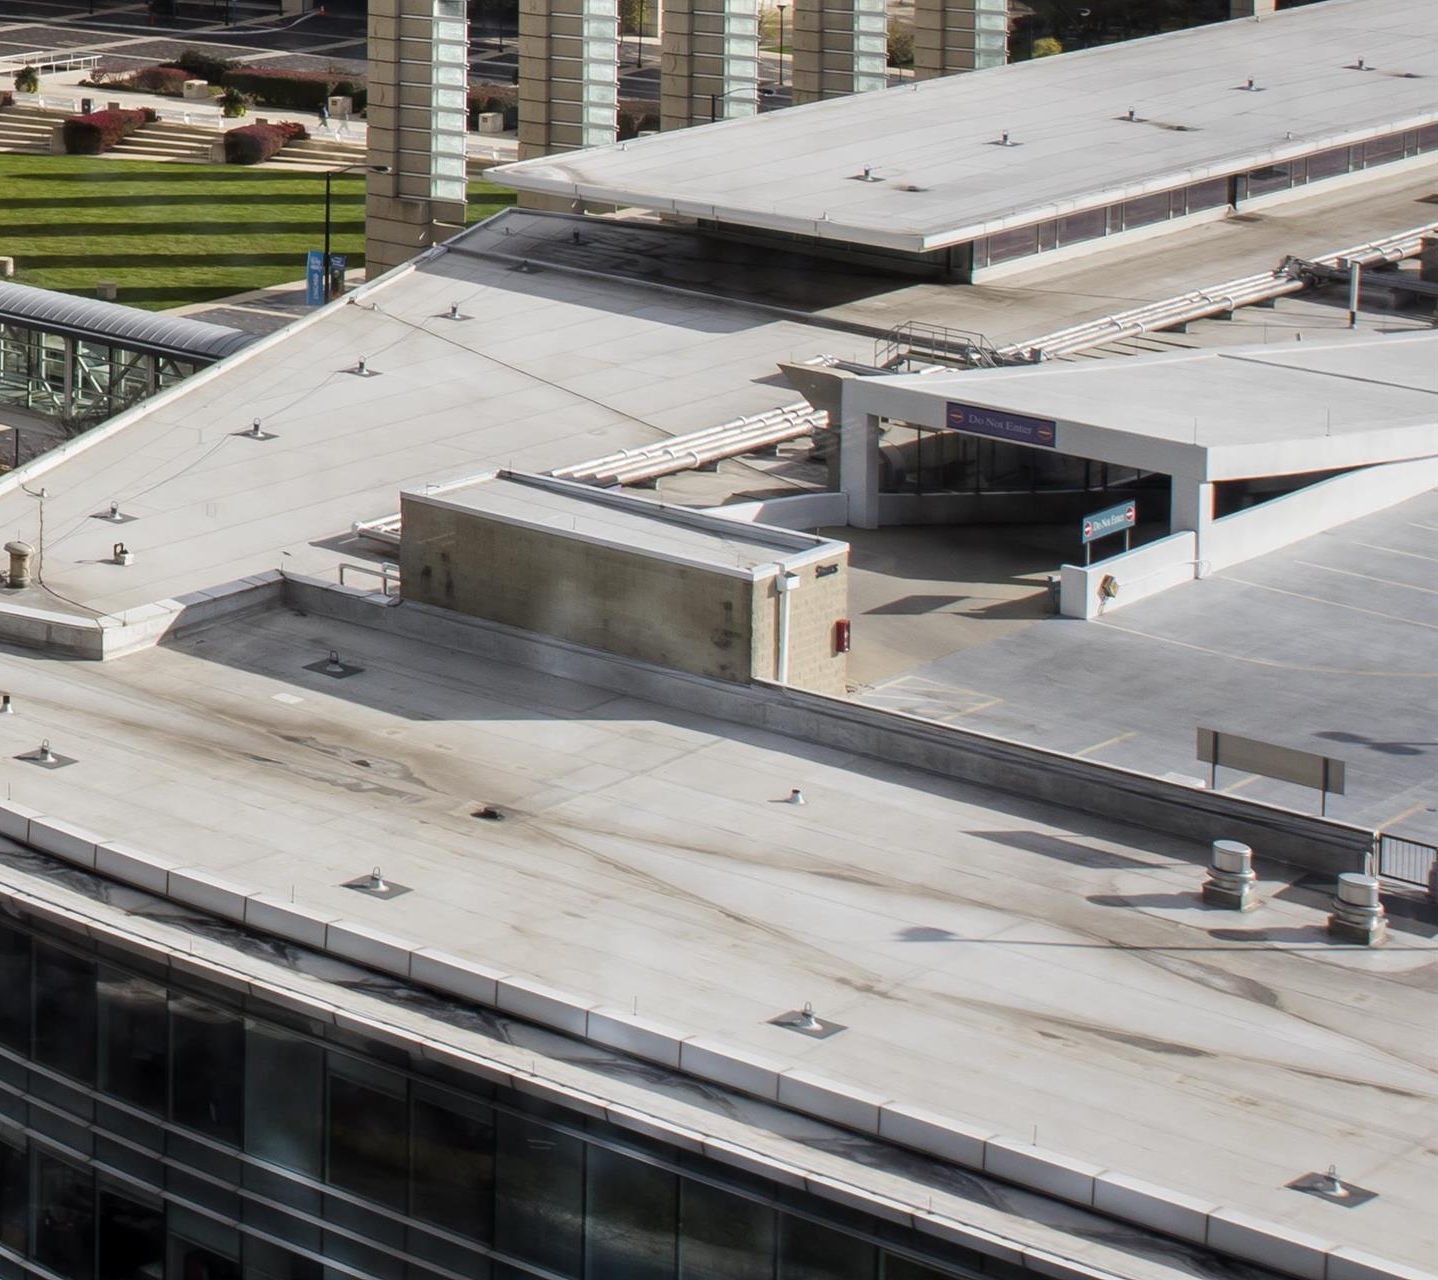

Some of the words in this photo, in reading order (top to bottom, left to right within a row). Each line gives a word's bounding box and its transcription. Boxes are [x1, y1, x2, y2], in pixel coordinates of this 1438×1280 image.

[968, 414, 984, 424] Do
[985, 418, 1004, 429] Not
[1005, 421, 1031, 434] Enter
[1093, 521, 1101, 531] Do
[1101, 518, 1111, 528] Not
[1111, 514, 1125, 525] Enter
